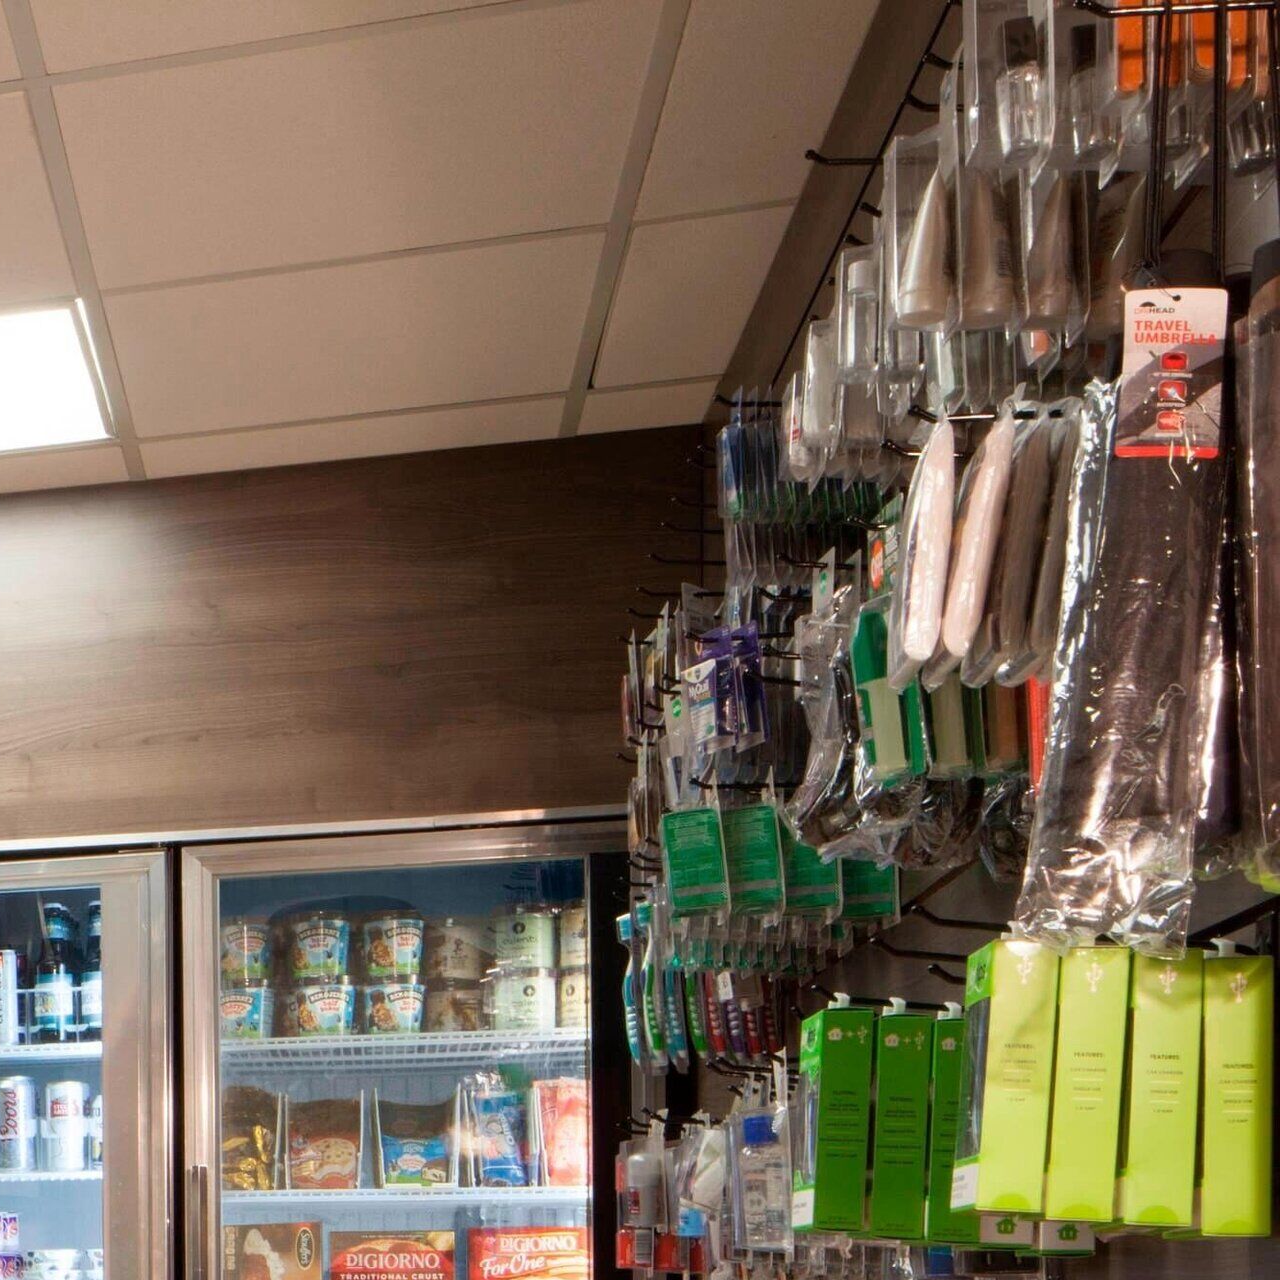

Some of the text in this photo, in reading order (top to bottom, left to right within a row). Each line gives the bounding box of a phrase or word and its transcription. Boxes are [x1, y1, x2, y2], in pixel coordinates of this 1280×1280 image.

[1135, 320, 1191, 331] TRAVEL
[1135, 332, 1217, 345] UMBRELLA
[0, 1089, 18, 1136] Coors
[413, 1272, 444, 1280] CRUST
